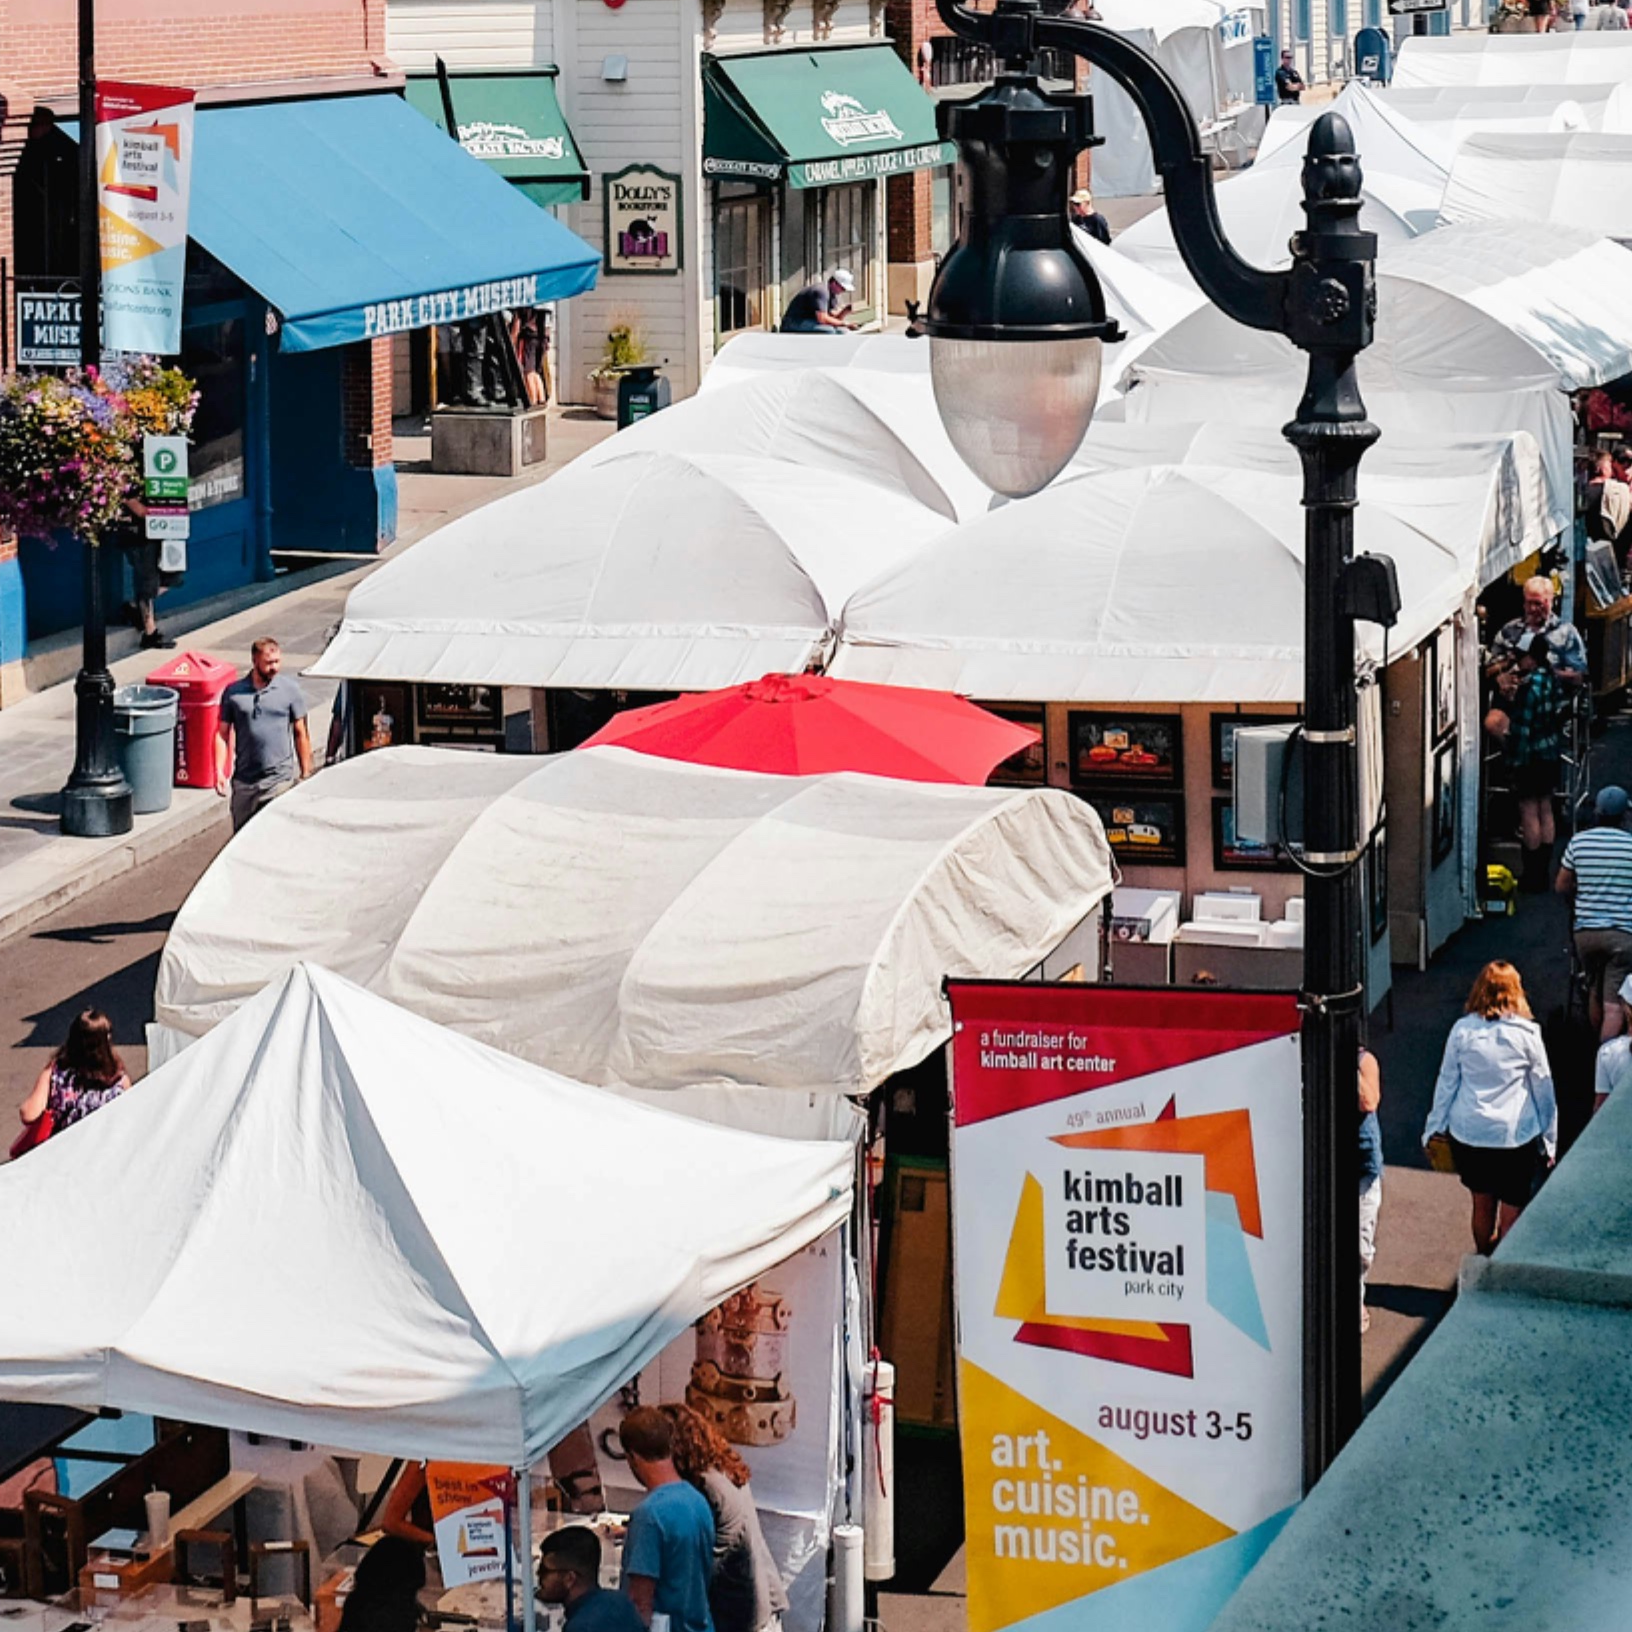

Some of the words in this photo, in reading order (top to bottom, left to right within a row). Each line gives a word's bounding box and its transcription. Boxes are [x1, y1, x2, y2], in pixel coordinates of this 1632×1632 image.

[123, 138, 158, 151] kimball
[123, 151, 142, 159] arts
[122, 160, 158, 171] festival
[143, 286, 172, 297] BANK
[23, 300, 70, 321] PARK
[363, 297, 414, 336] PARK
[419, 289, 460, 325] CITY
[463, 274, 538, 317] MUSEUM
[34, 325, 104, 345] MUSE
[159, 453, 172, 470] P
[149, 480, 161, 496] 3
[980, 1032, 989, 1046] a
[993, 1029, 1065, 1049] fundraiser
[1068, 1032, 1088, 1050] for
[981, 1051, 1037, 1068] kimball
[1041, 1054, 1064, 1070] art
[1067, 1055, 1116, 1072] center
[1096, 1101, 1146, 1125] annual
[1064, 1169, 1183, 1207] kimball
[1066, 1206, 1130, 1236] arts
[1066, 1238, 1184, 1276] festival
[1125, 1279, 1156, 1296] park
[1159, 1280, 1184, 1301] city
[1098, 1404, 1197, 1439] august
[1205, 1410, 1252, 1441] 3-5
[991, 1429, 1062, 1471] art.
[435, 1475, 463, 1489] best
[465, 1480, 479, 1489] in
[992, 1473, 1149, 1525] cuisine.
[994, 1521, 1128, 1569] music.
